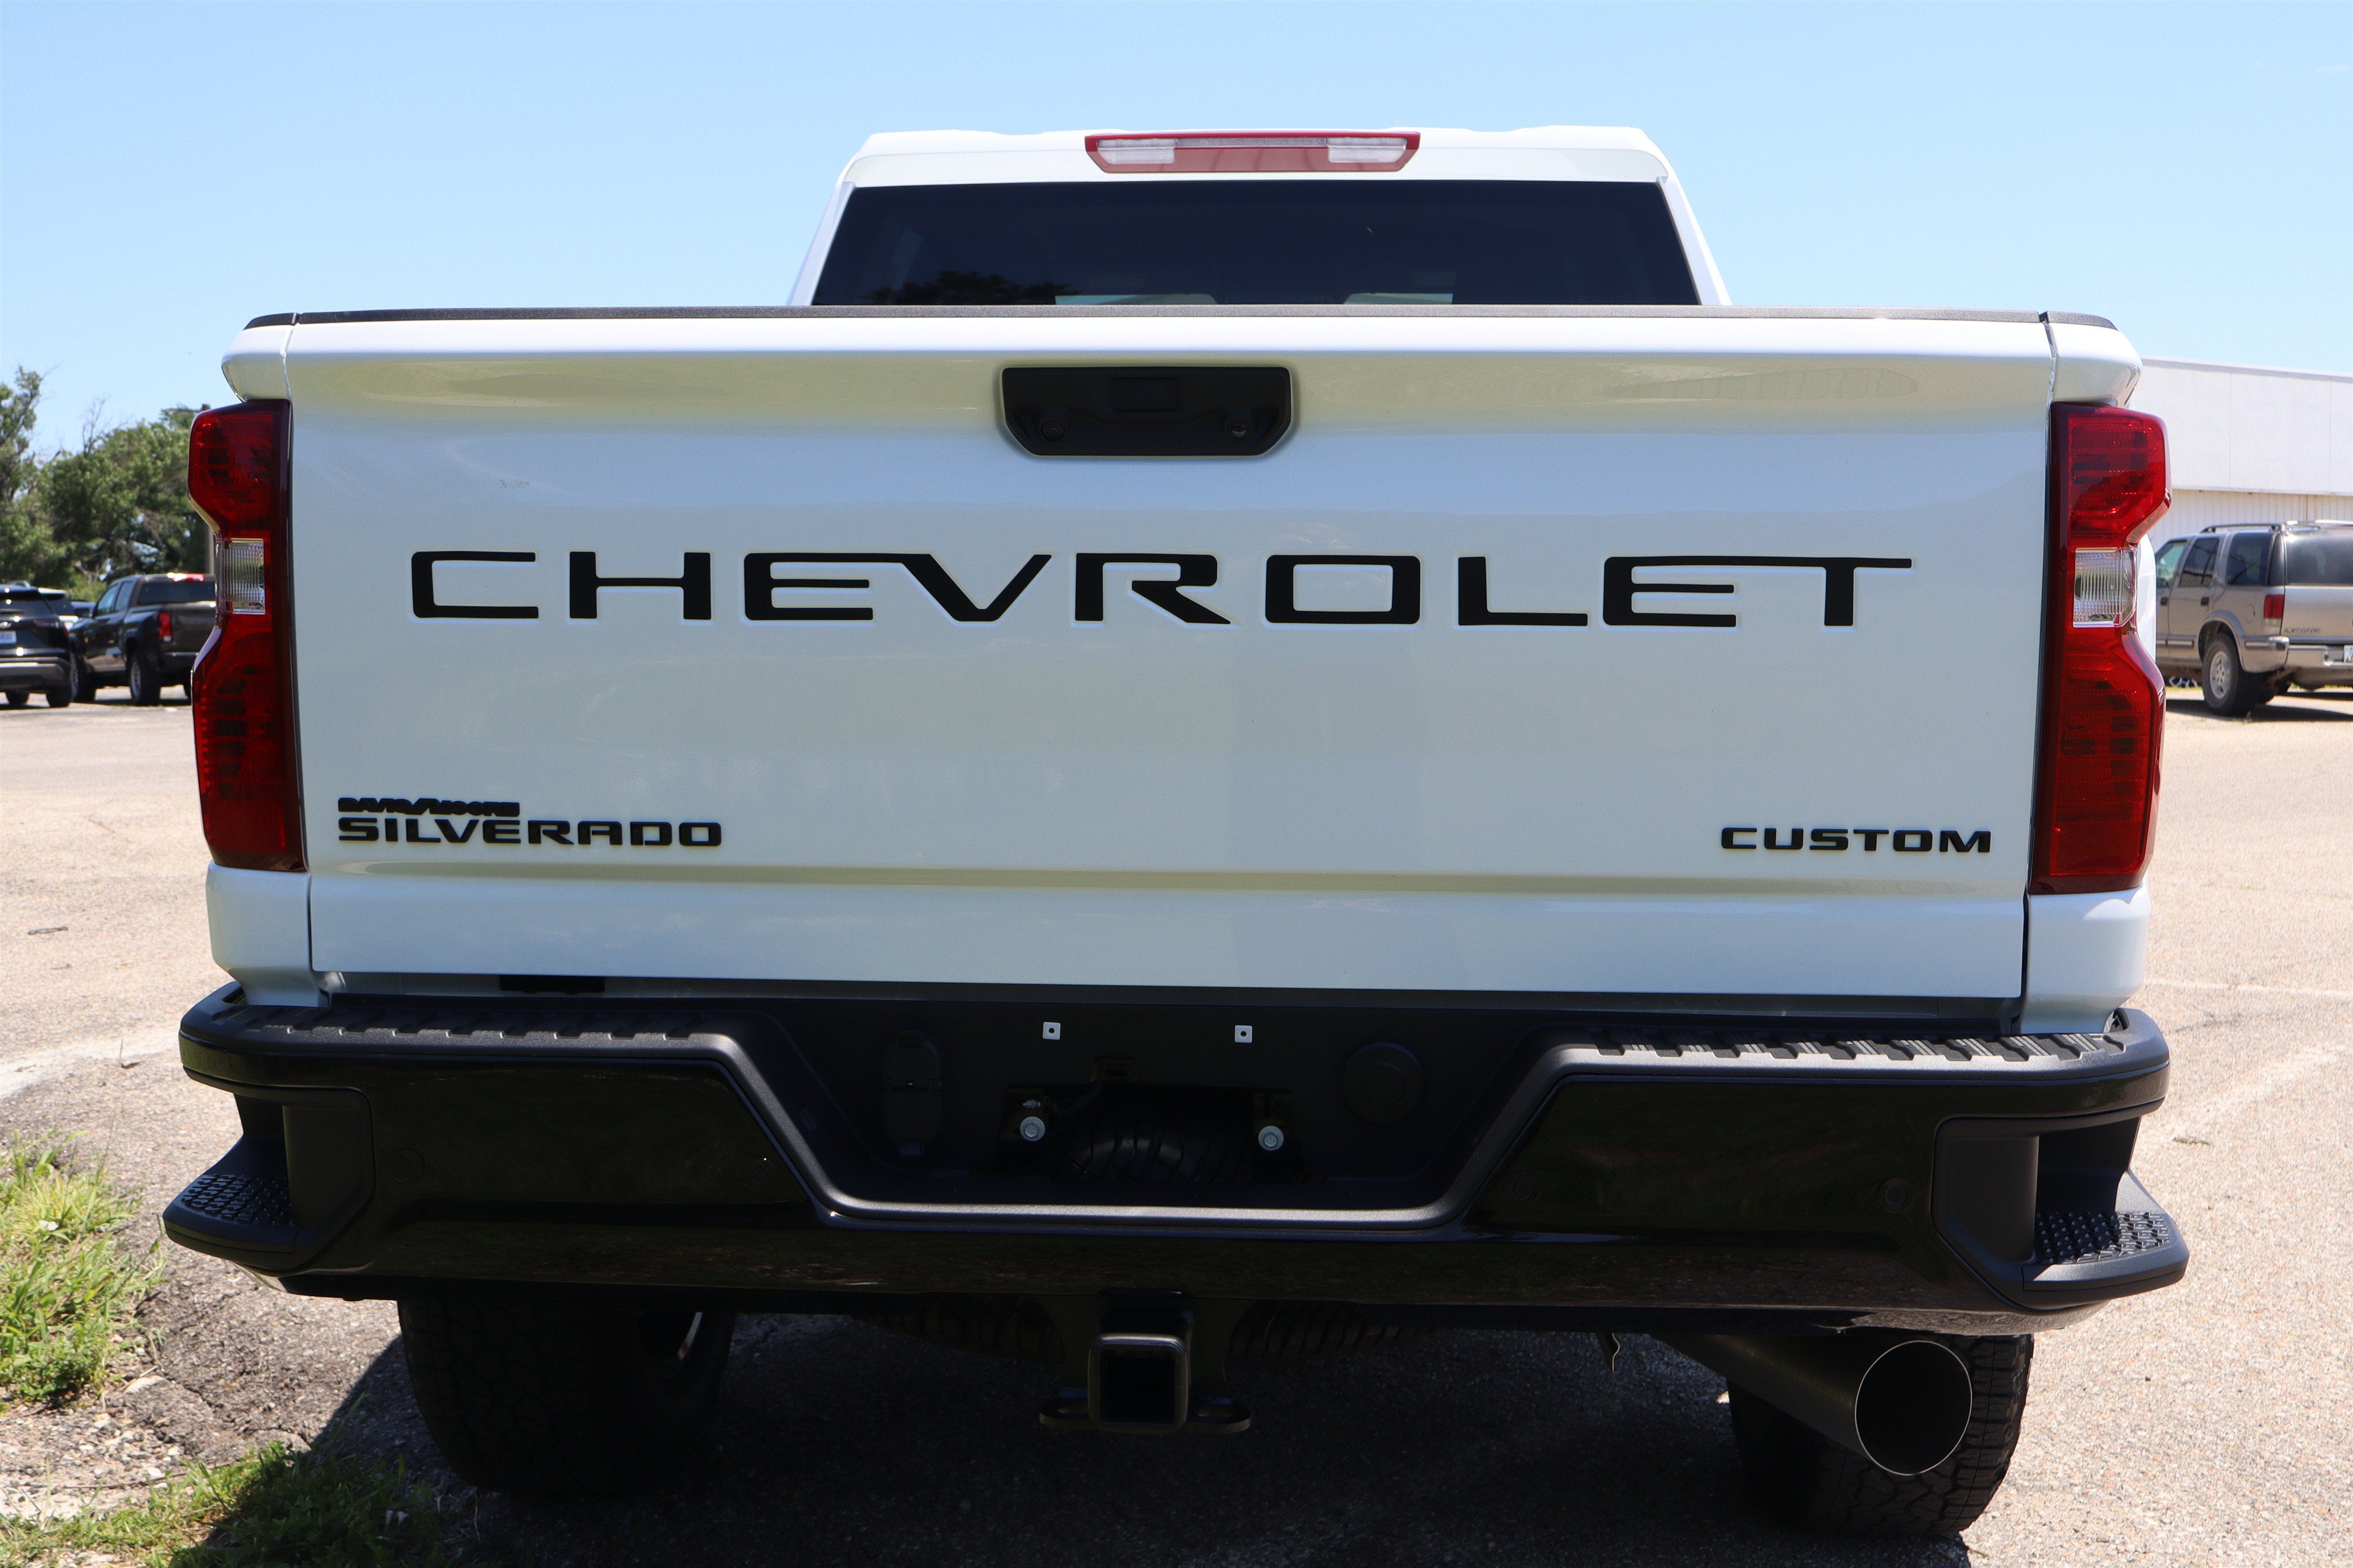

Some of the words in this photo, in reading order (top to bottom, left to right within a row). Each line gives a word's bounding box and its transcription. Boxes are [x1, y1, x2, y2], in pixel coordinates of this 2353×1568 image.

[411, 550, 1913, 628] CHEVROLET
[338, 817, 722, 847] SILVERADO
[1721, 827, 1992, 853] CUSTOM
